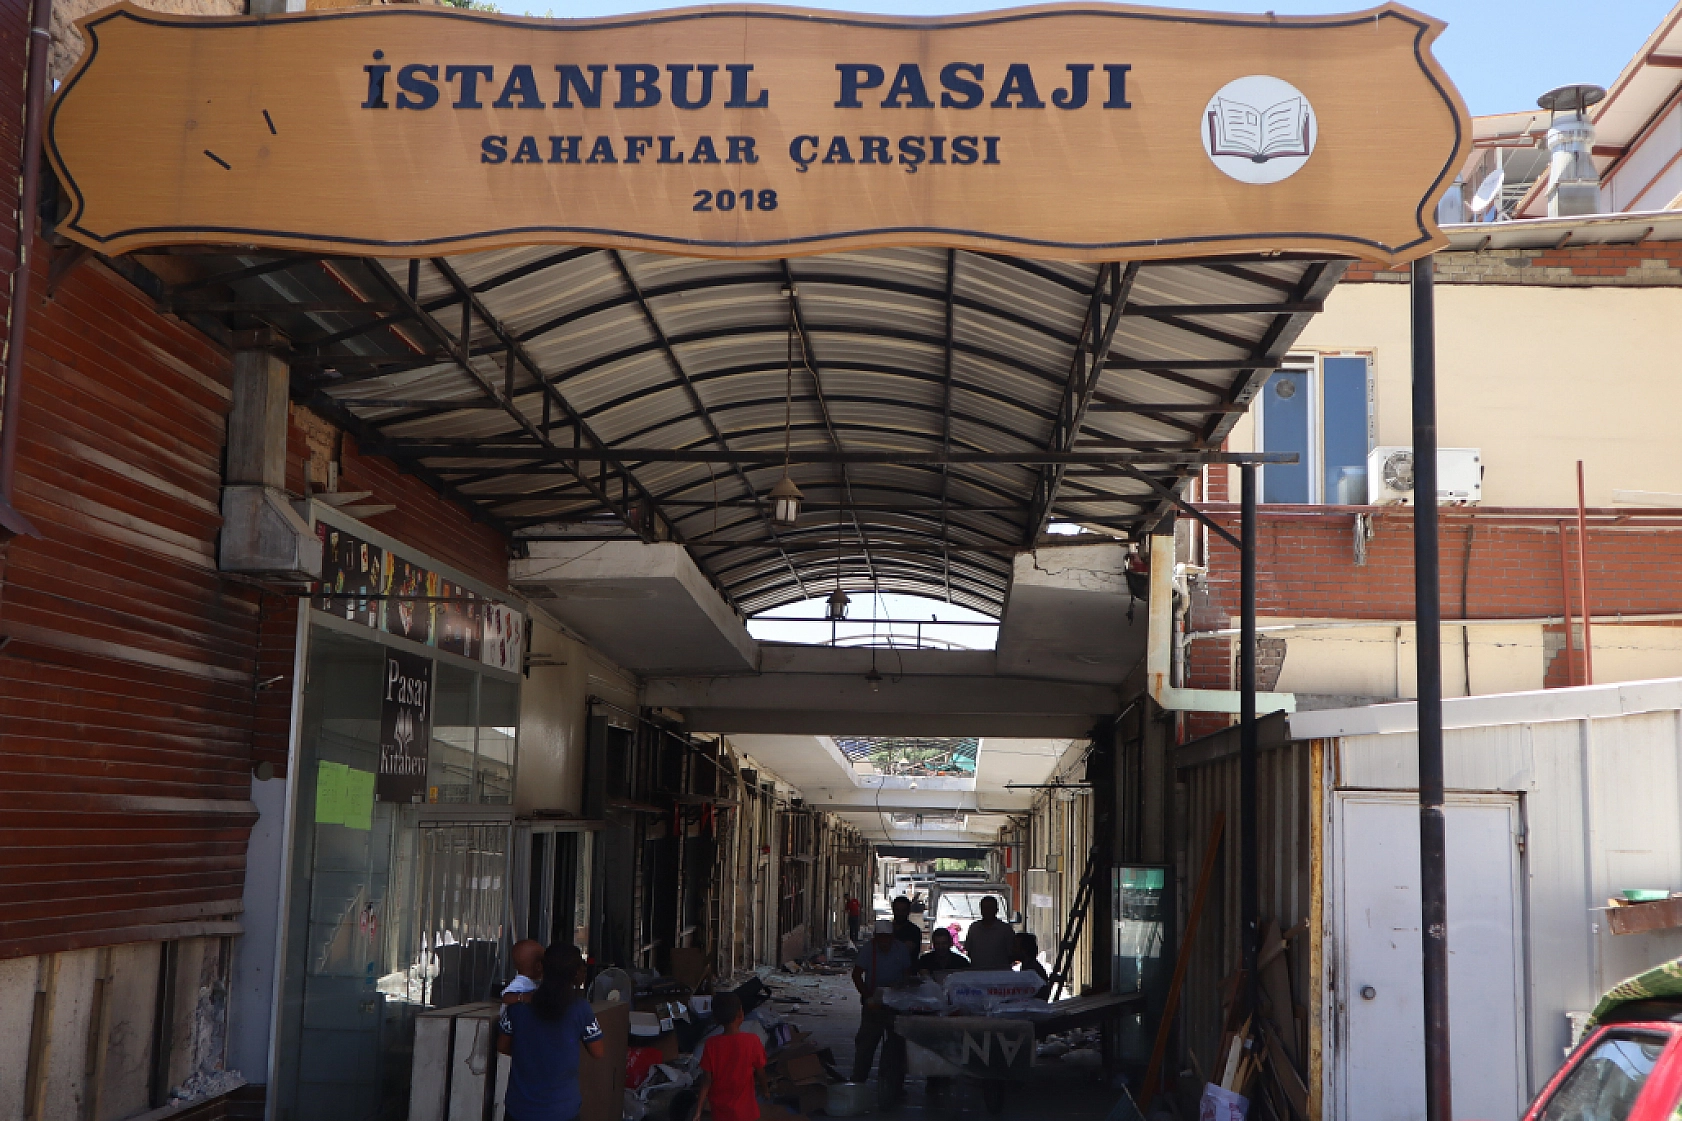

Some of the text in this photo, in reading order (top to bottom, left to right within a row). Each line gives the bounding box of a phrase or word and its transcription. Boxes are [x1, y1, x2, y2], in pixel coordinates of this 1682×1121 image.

[361, 49, 1132, 110] İSTANBUL PASAJI
[480, 134, 1001, 174] SAHAFLAR ÇARŞISI
[692, 189, 779, 212] 2018
[385, 658, 428, 722] Pasaj
[379, 743, 427, 777] Kitabevi
